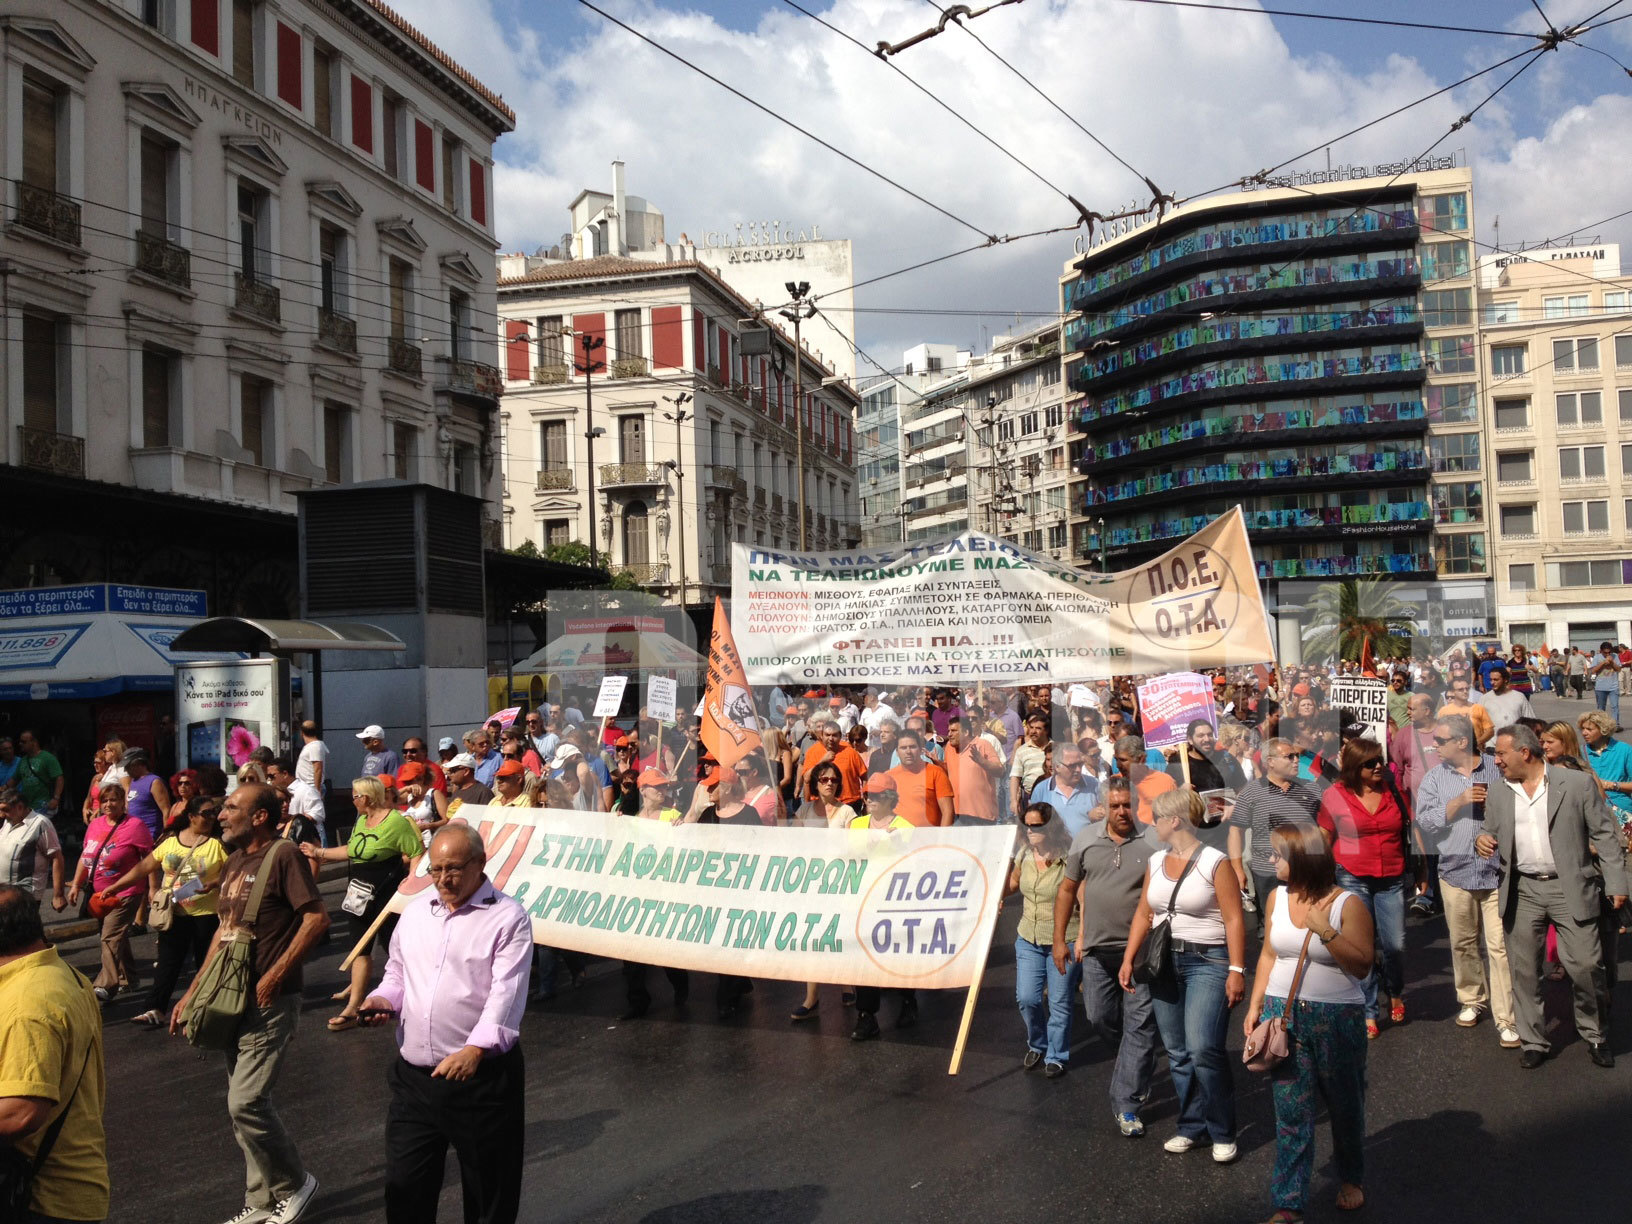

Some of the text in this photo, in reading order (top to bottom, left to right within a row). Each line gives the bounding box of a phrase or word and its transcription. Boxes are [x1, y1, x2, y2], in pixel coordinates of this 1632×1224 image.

[185, 77, 282, 145] ΜΠΑΓΚΕΙΟΝ
[706, 225, 823, 248] CLASSICAL
[728, 247, 805, 264] ACROPOL
[750, 551, 819, 566] ΠΡΙΝ
[829, 551, 895, 566] ΜΑΣ
[749, 570, 782, 581] ΝΑ
[790, 558, 965, 581] ΤΕΛΕΙΩΝΟΥΜΕ
[1147, 550, 1219, 596] Π.Ο.Ε.
[38, 588, 95, 602] περιπτεράς
[117, 587, 145, 599] Επειδή
[155, 592, 198, 604] περιπτεράς
[749, 591, 812, 600] ΜΕΙΩΝΟΥΝ:
[814, 590, 865, 600] ΜΙΣΘΟΥΣ,
[914, 583, 934, 592] ΚΑΙ
[938, 580, 1001, 591] ΣΥΝΤΑΞΕΙΣ
[0, 604, 17, 615] δεν
[21, 605, 32, 613] τα
[35, 602, 60, 614] ξέρει
[124, 599, 140, 609] δεν
[141, 603, 150, 611] τα
[152, 601, 173, 613] ξέρει
[749, 602, 812, 611] ΑΥΞΑΝΟΥΝ:
[815, 602, 841, 611] ΟΡΙΑ
[890, 593, 962, 606] ΣΥΜΜΕΤΟΧΗ
[966, 592, 980, 601] ΣΕ
[749, 603, 1110, 622] ΑΠΟΛΥΟΥΝ: ΔΗΜΟΣΙΟΥΣ ΥΠΑΛΛΗΛΟΥΣ, ΚΑΤΑΡΓΟΥΝ ΔΙΚΑΙΩΜΑΤΑ
[1155, 598, 1227, 639] Ο.Τ.Α.
[748, 624, 810, 633] ΔΙΑΛΥΟΥΝ:
[812, 623, 857, 633] ΚΡΑΤΟΣ,
[897, 618, 945, 628] ΠΑΙΔΕΙΑ
[948, 616, 968, 626] ΚΑΙ
[972, 615, 1052, 625] ΝΟΣΟΚΟΜΕΙΑ
[1447, 626, 1485, 635] ΟΠΤΙΚΑ
[832, 634, 1014, 650] ΦΤΑΝΕΙ ΠΙΑ...!!!
[747, 647, 1126, 666] ΜΠΟΡΟΥΜΕ & ΠΡΕΠΕΙ ΝΑ ΤΟΥΣ ΣΤΑΜΑΤΗΣΟΥΜΕ
[803, 662, 1049, 678] ΟΙ ΑΝΤΟΧΕΣ ΜΑΣ ΤΕΛΕΙΩΣΑΝ
[186, 691, 204, 699] Κάνε
[215, 690, 231, 699] iPad
[232, 689, 249, 698] δικό
[1141, 684, 1160, 696] 30
[1332, 688, 1386, 705] ΑΠΕΡΓΙΕΣ
[531, 833, 612, 874] ΣΤΗΝ
[609, 843, 760, 890] ΑΦΑΙΡΕΣΗ
[759, 854, 868, 895] ΠΟΡΩΝ
[885, 869, 968, 901] Π.Ο.Ε.
[512, 881, 843, 953] & ΑΡΜΟΔΙΟΤΗΤΩΝ ΤΩΝ Ο.Τ.Α.
[872, 917, 956, 954] Ο.Τ.Α.
